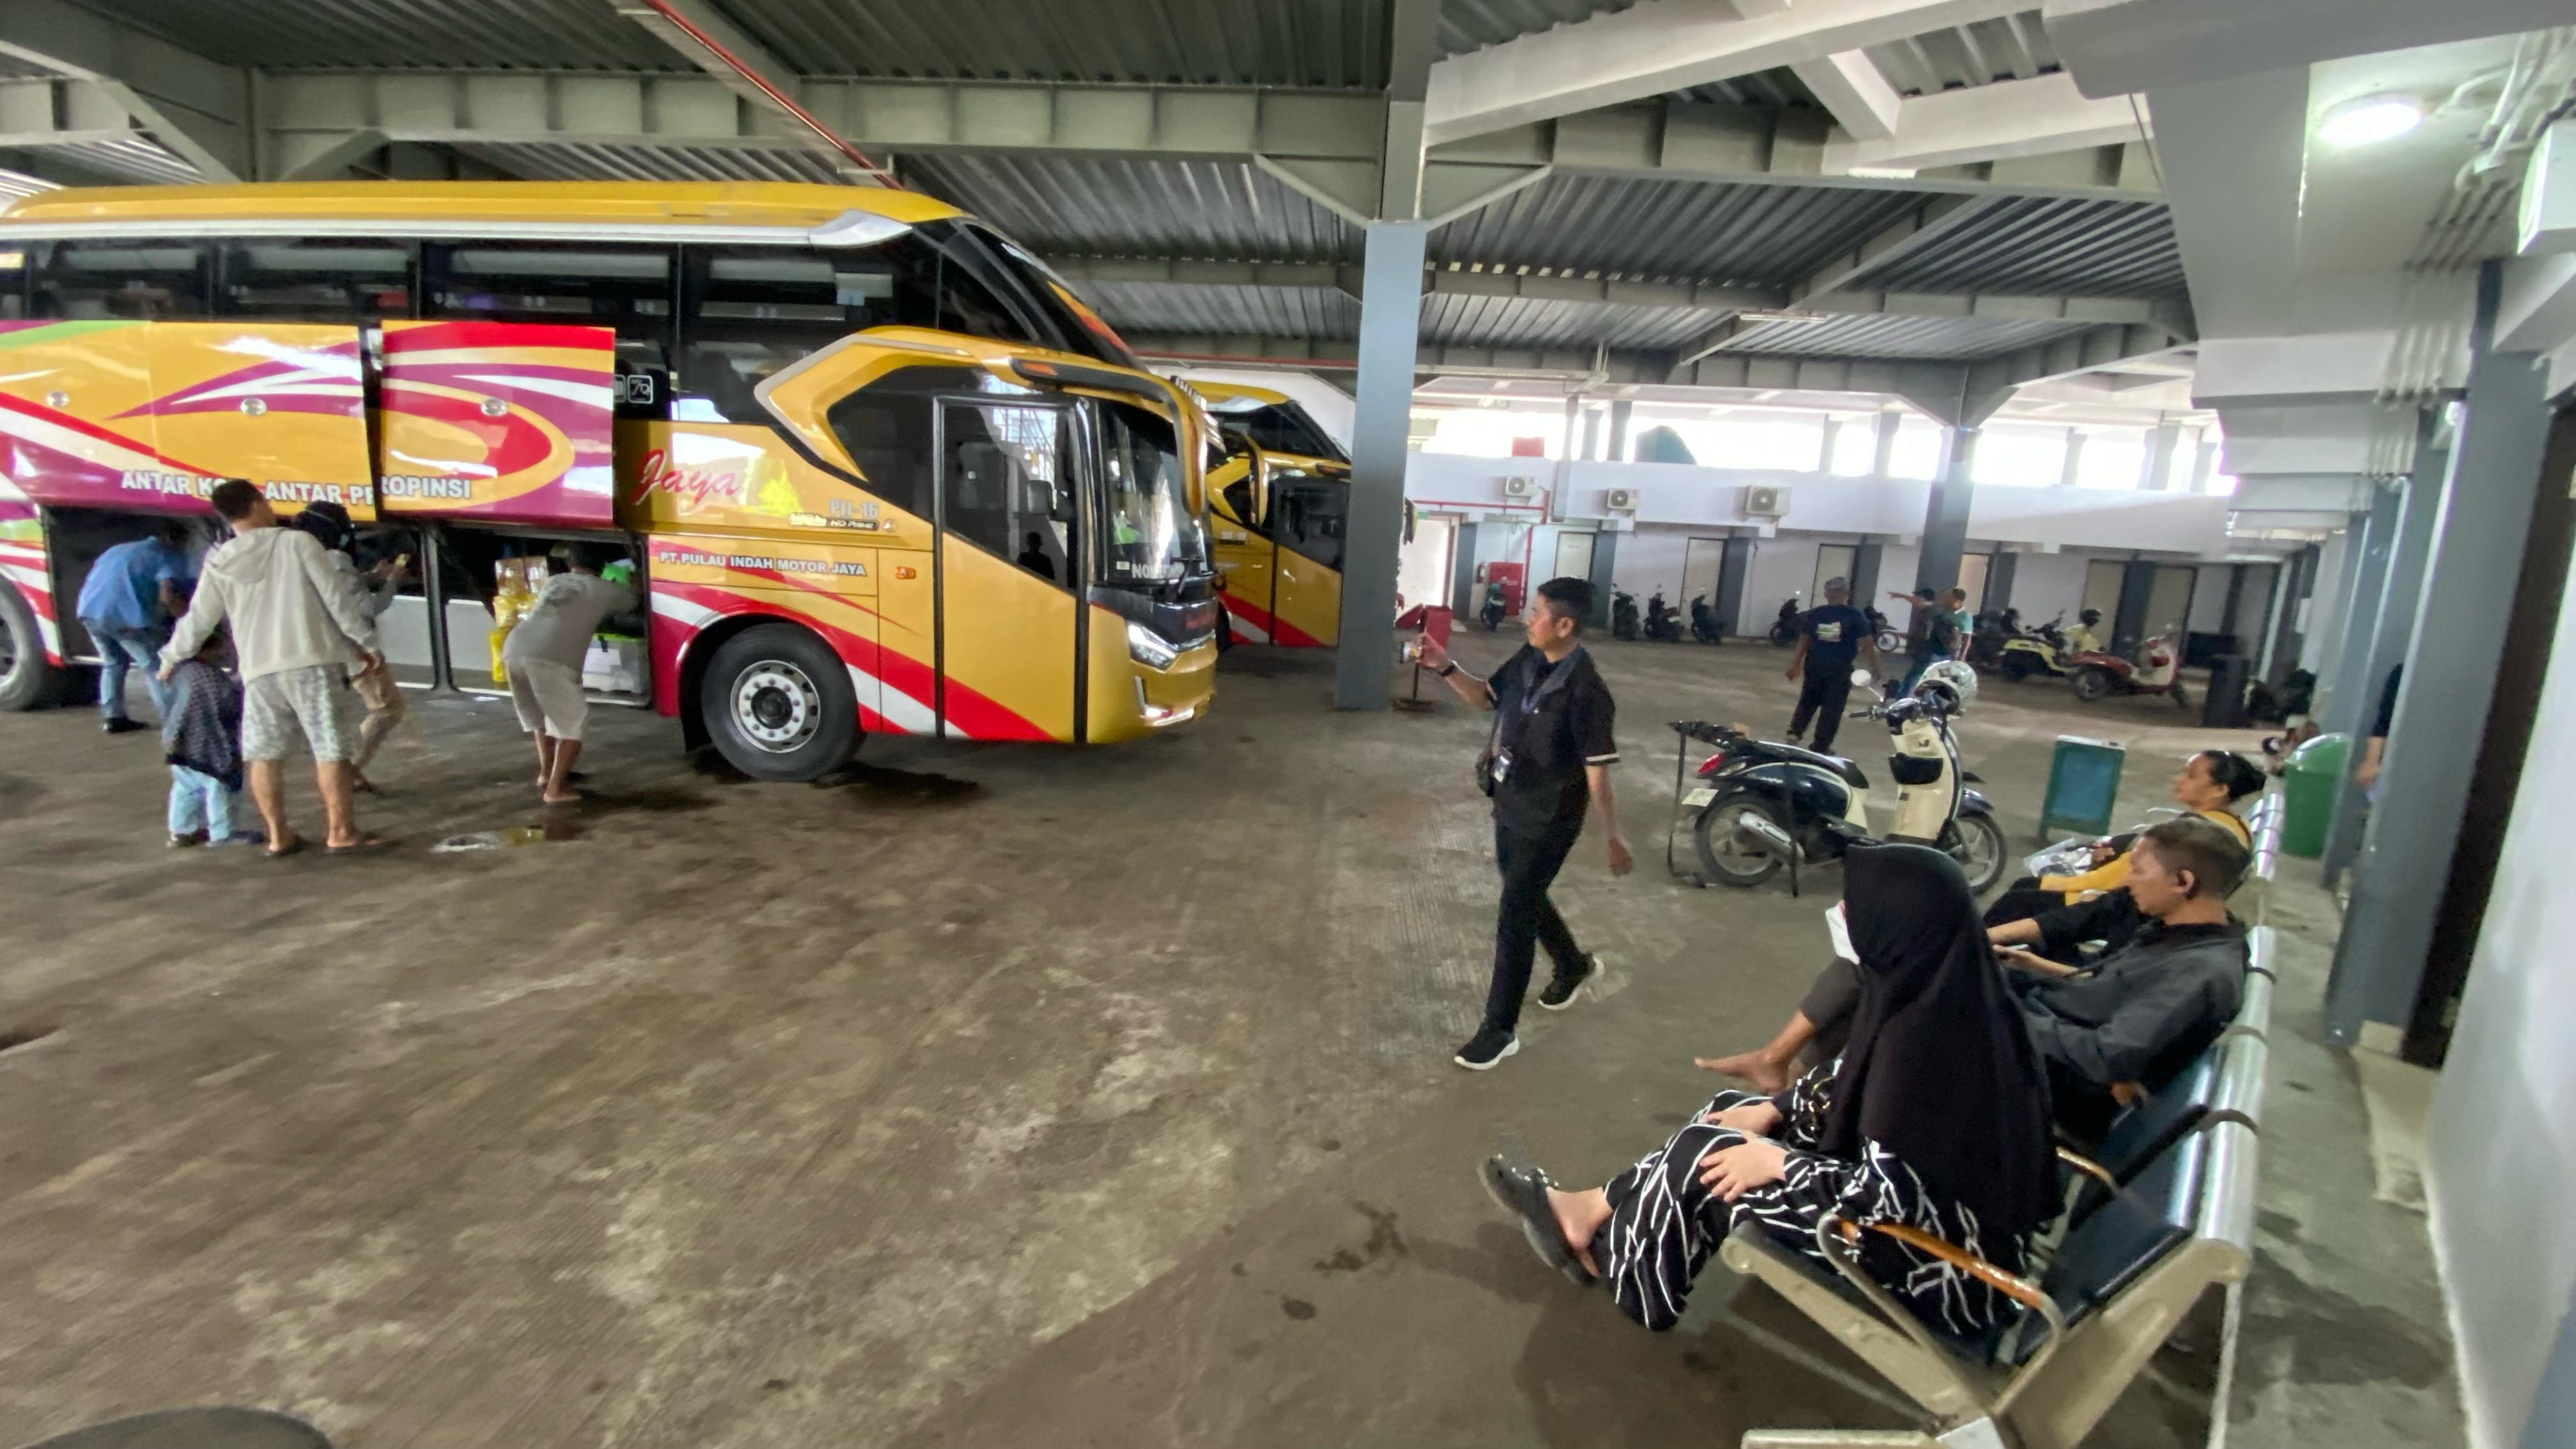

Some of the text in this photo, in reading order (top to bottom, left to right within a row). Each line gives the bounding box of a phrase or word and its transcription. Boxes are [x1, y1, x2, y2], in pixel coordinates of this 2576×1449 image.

[122, 471, 190, 494] ANTAR
[264, 480, 343, 505] ANTAR
[629, 449, 740, 505] Jaya
[680, 553, 726, 566] PULAU
[730, 555, 774, 570] INDAH
[777, 559, 827, 572] MOTOR
[831, 563, 868, 576] JAYA
